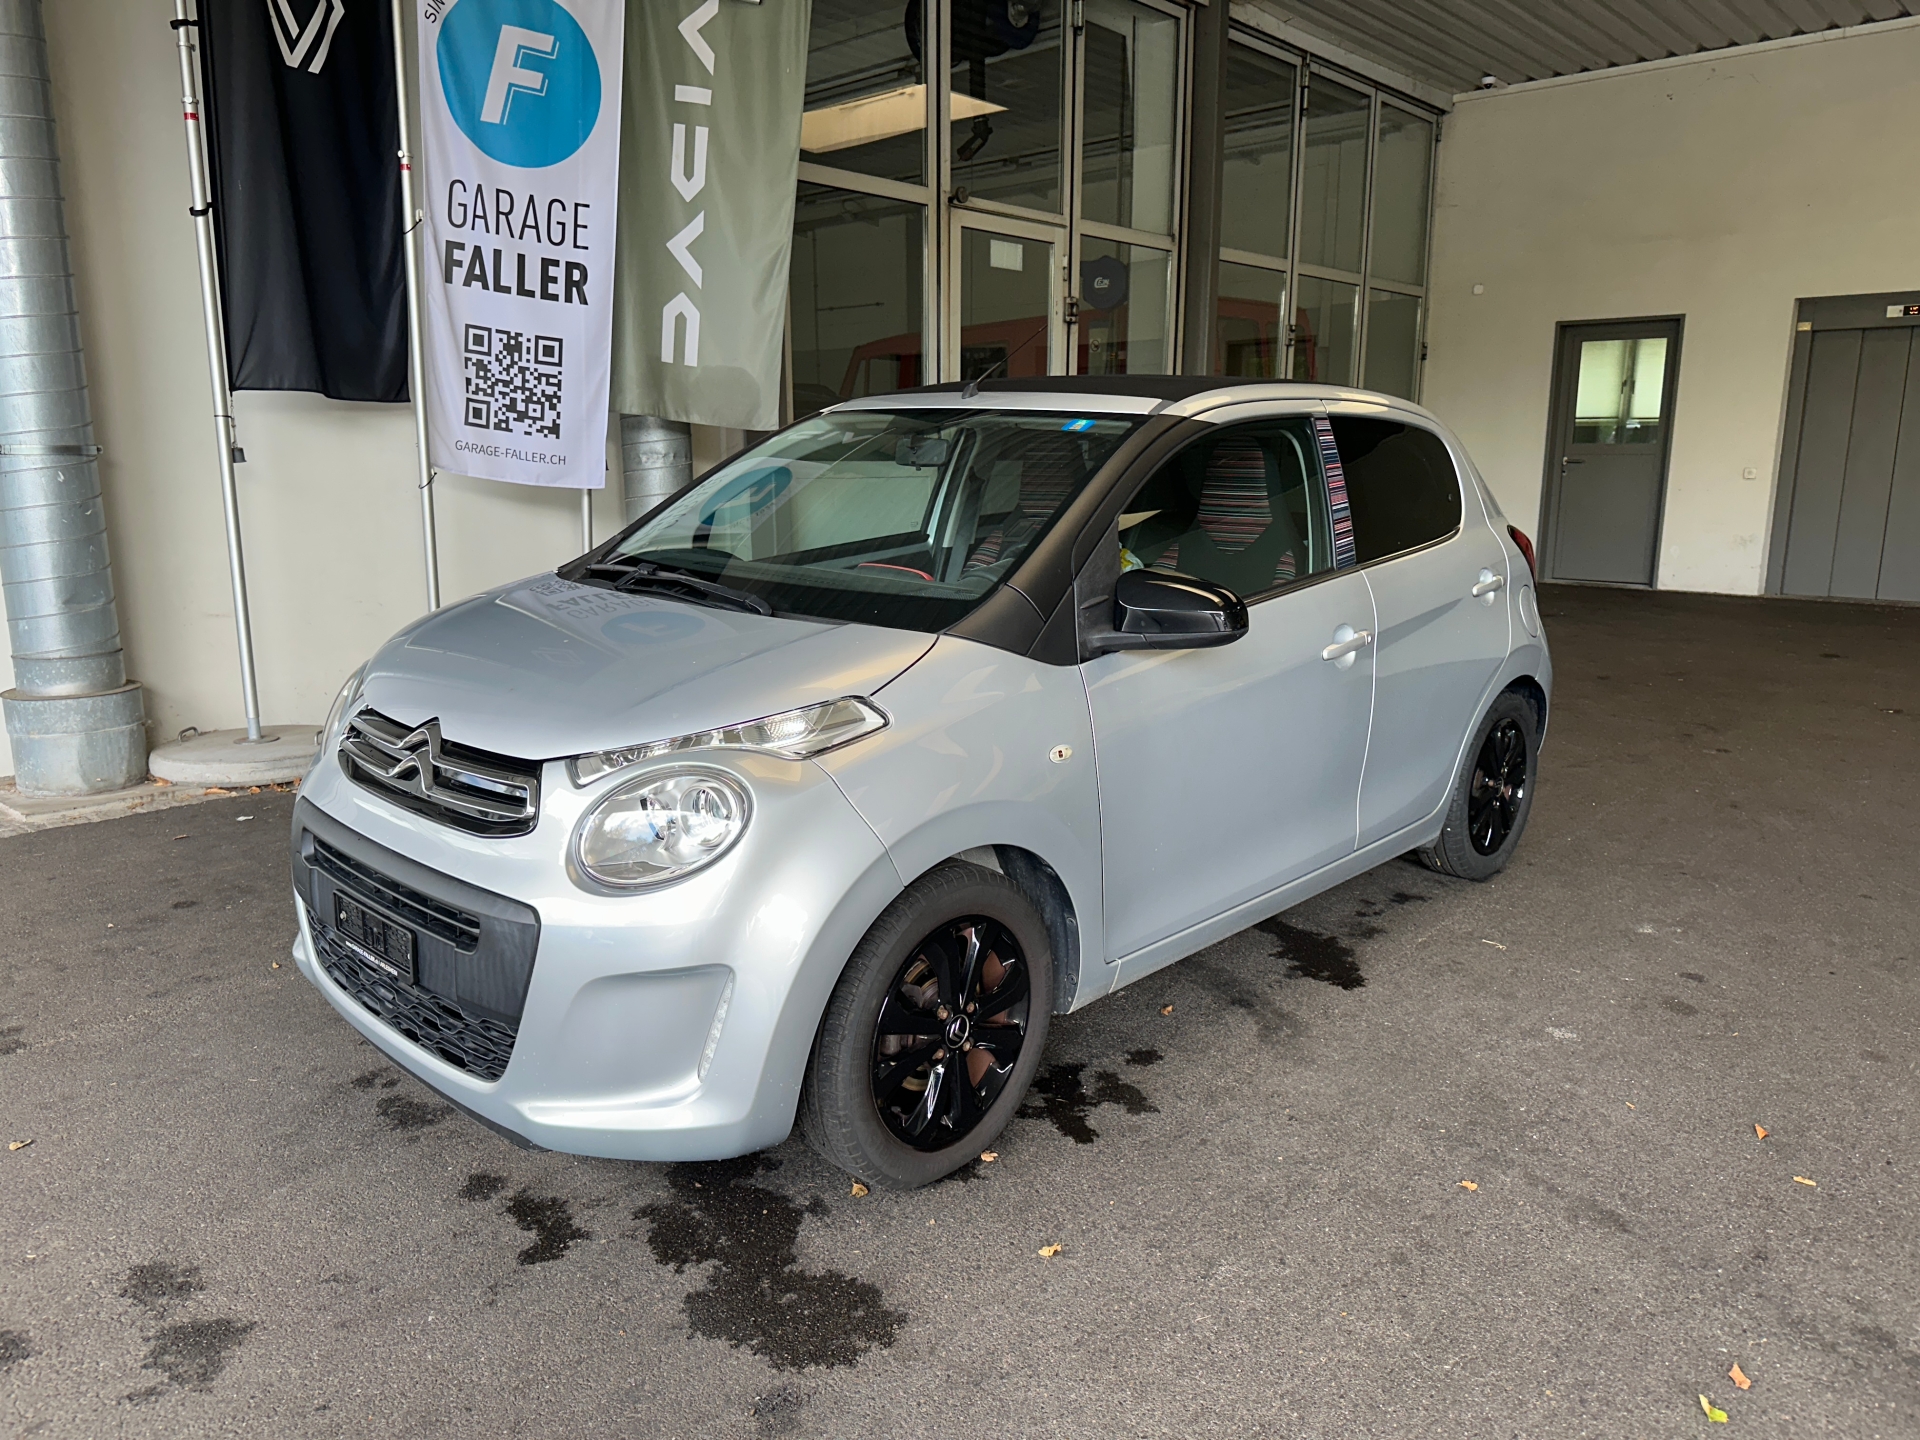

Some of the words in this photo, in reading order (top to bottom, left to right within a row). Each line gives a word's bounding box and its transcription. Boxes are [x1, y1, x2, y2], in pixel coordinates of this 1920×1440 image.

[480, 24, 559, 125] F
[447, 179, 590, 250] GARAGE
[444, 240, 589, 305] FALLER
[454, 439, 567, 466] GARAGE-FALLER.CH
